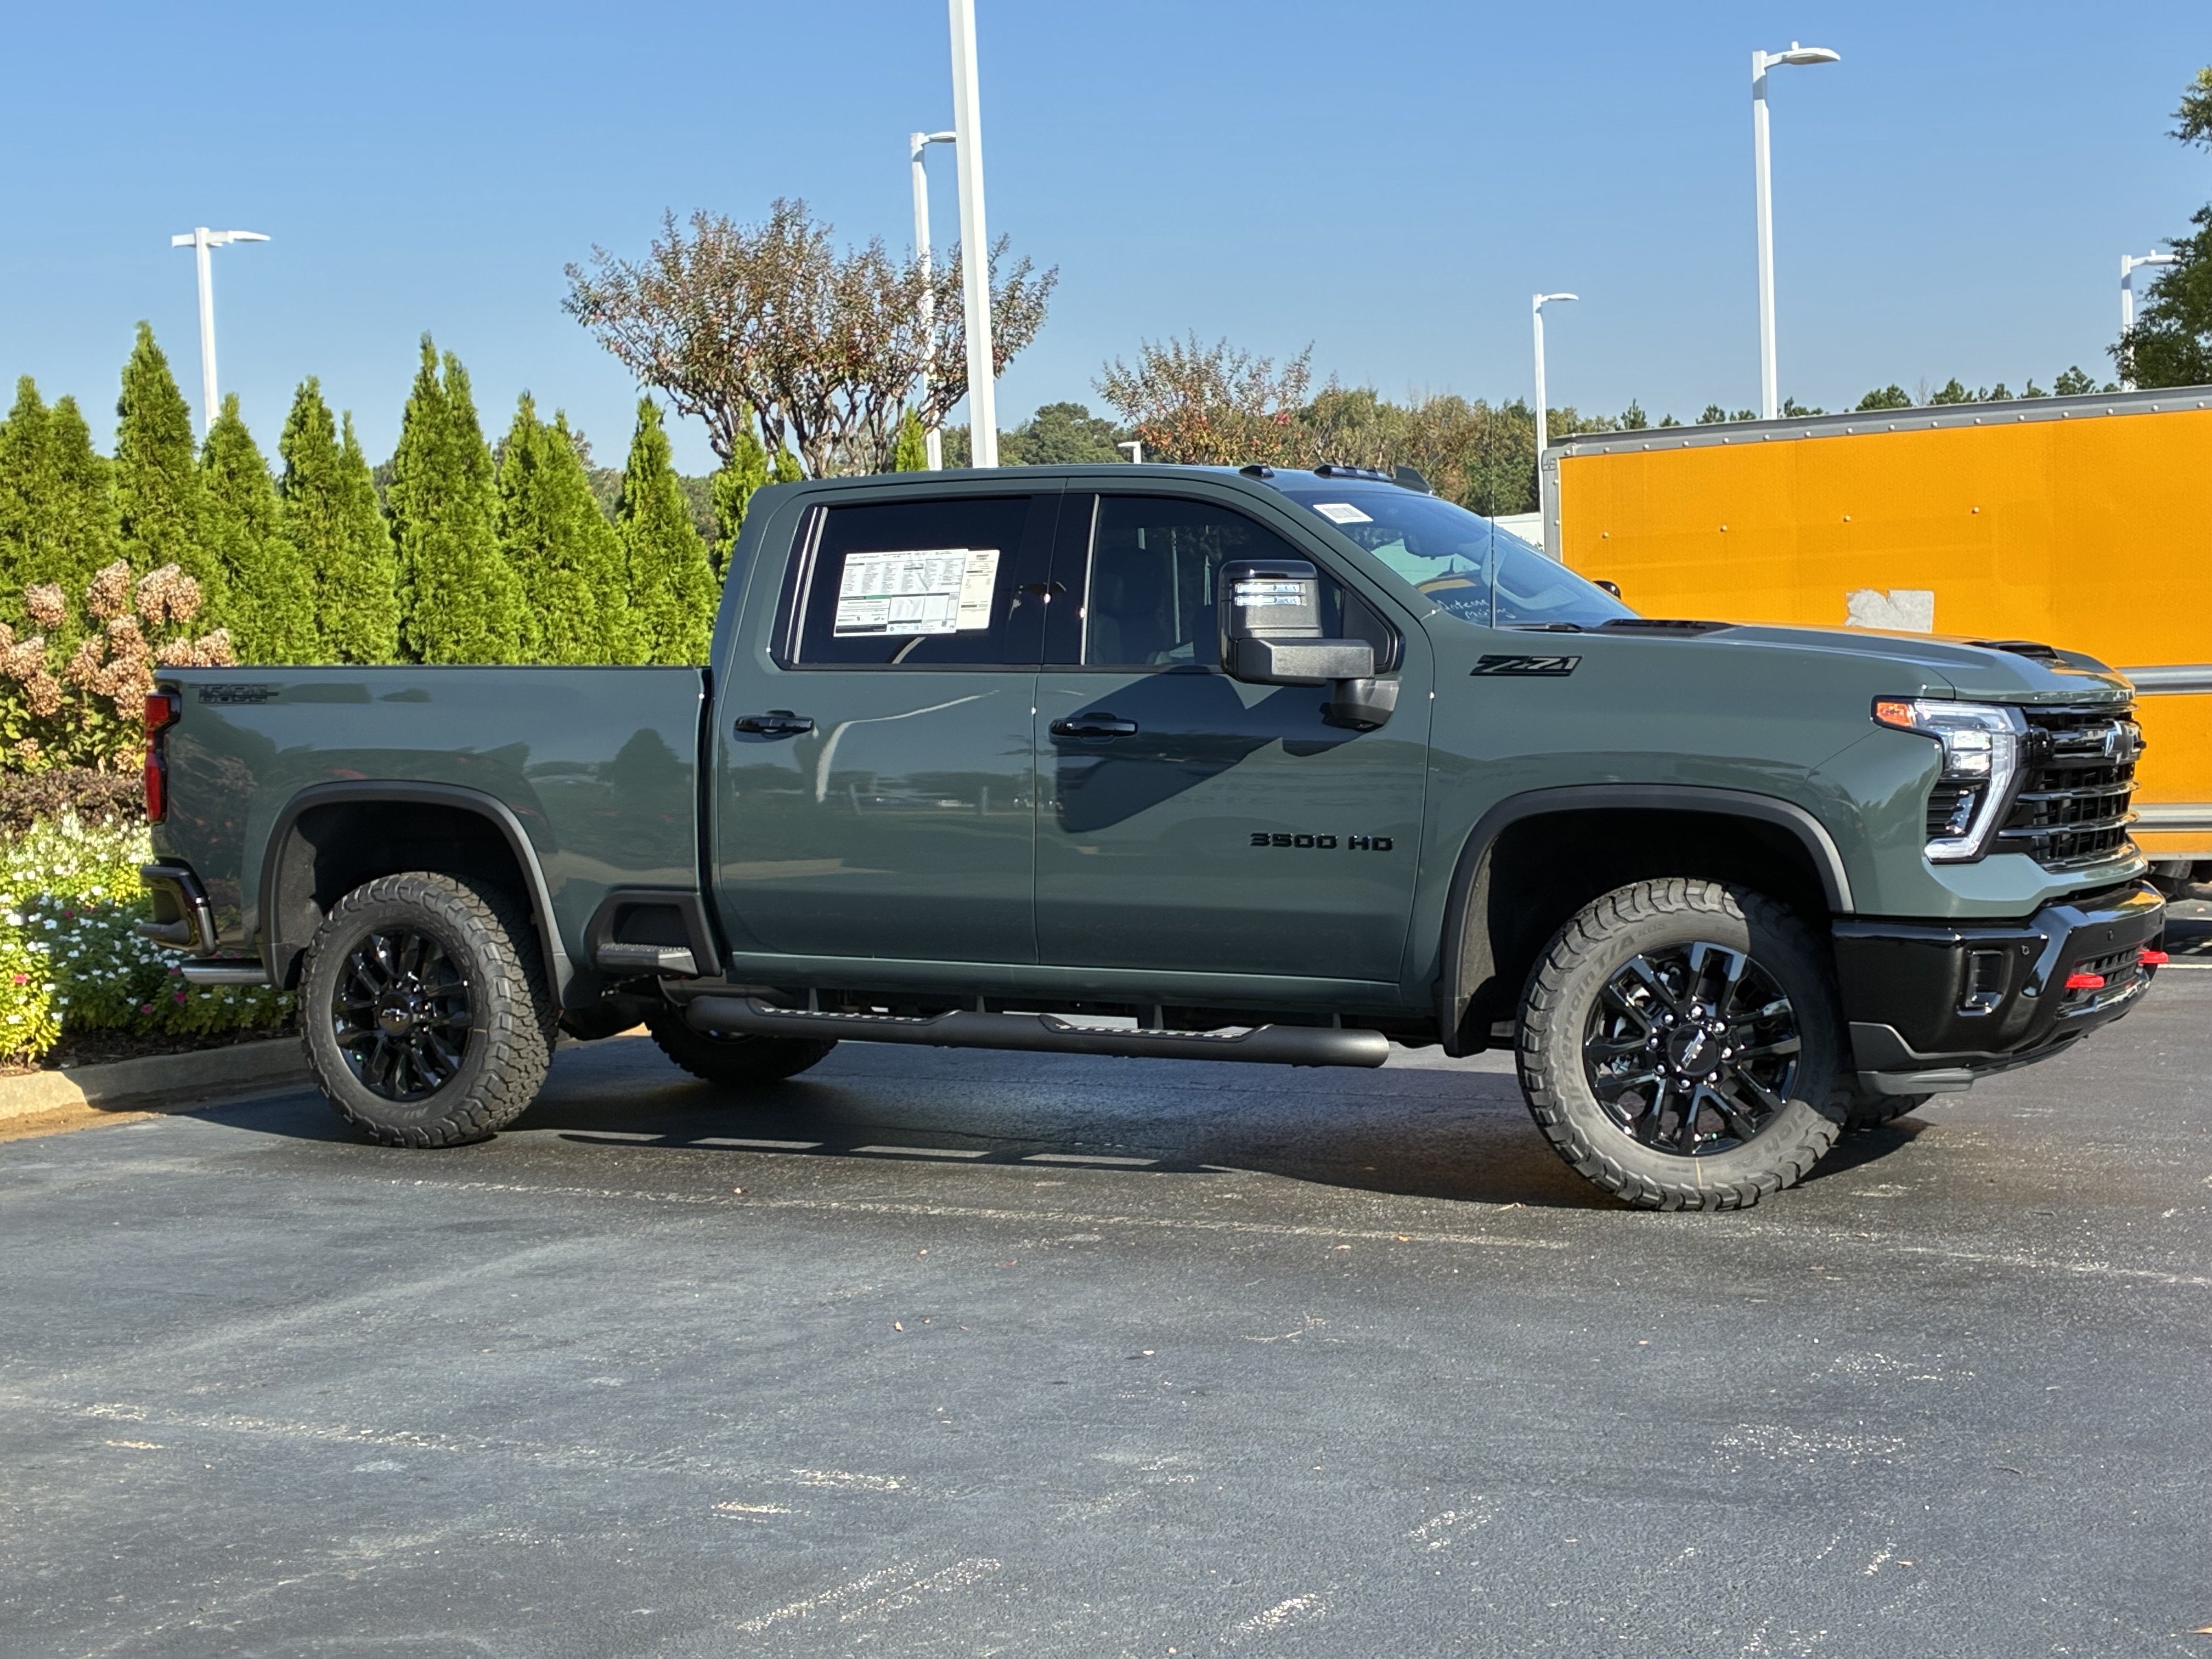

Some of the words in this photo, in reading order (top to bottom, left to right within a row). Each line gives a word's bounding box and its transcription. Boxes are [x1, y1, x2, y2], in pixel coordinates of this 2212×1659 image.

[1469, 654, 1584, 677] Z71
[1250, 832, 1339, 849] 3500
[1347, 835, 1395, 851] HD
